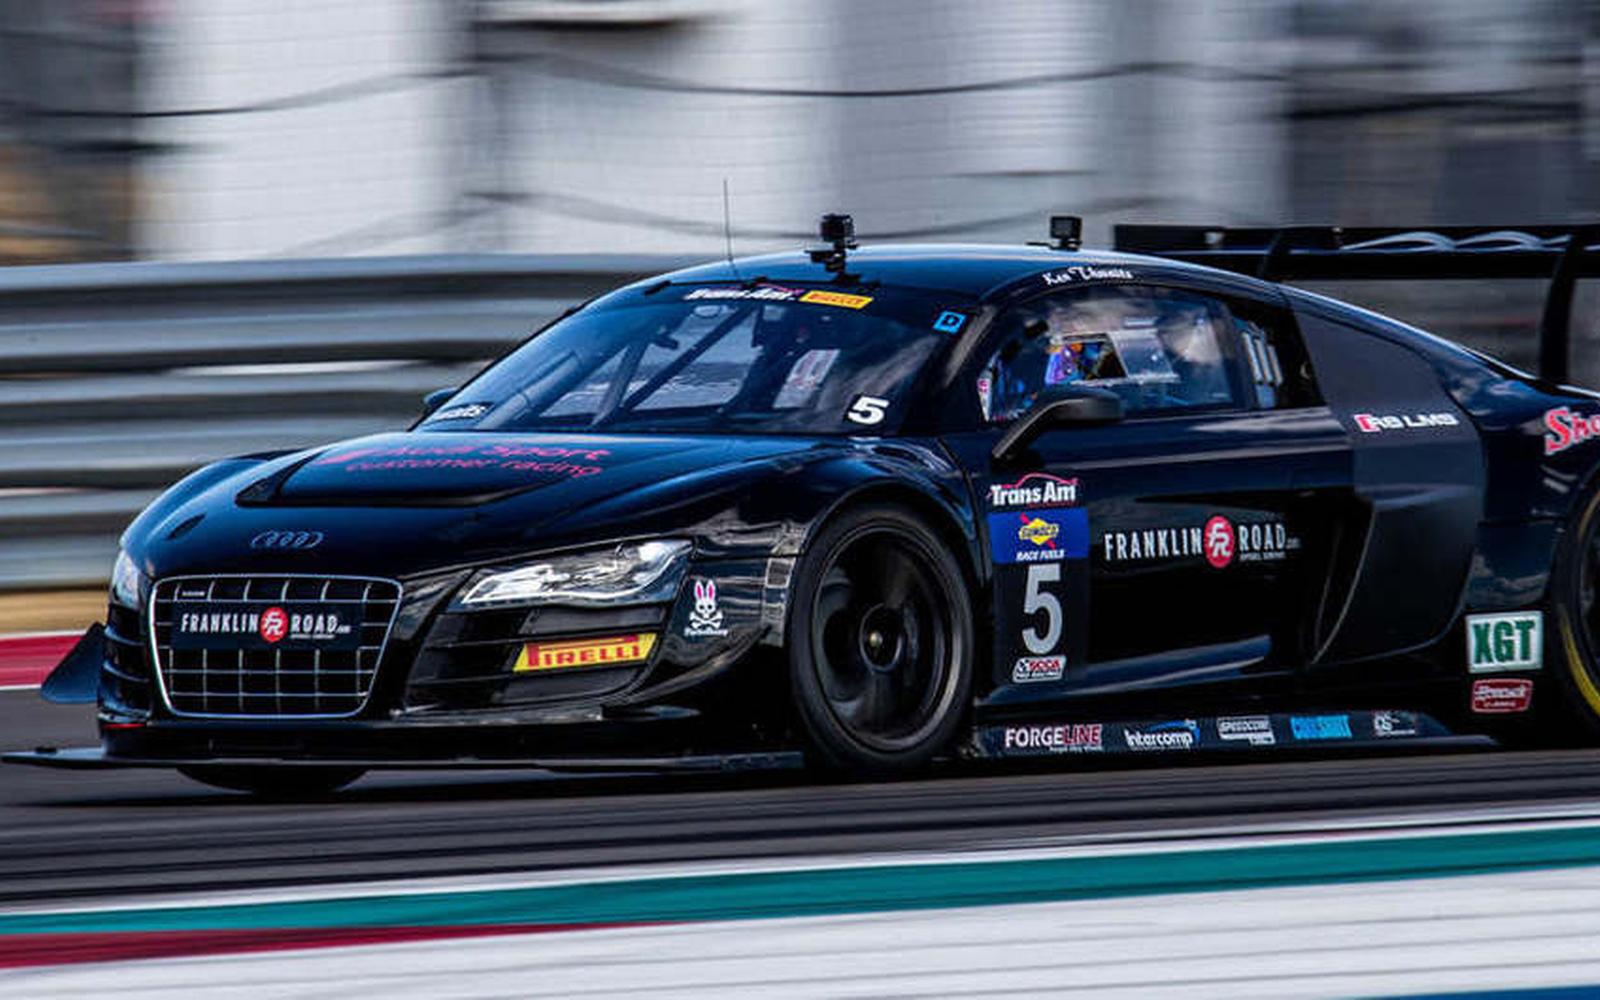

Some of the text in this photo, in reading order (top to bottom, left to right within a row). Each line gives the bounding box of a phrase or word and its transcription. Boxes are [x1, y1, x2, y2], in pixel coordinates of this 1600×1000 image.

[847, 396, 890, 425] 5
[1104, 527, 1203, 561] FRANKLIN
[181, 613, 260, 633] FRANKLIN
[1022, 562, 1062, 655] 5
[526, 634, 641, 668] PIRELLI
[1471, 620, 1536, 664] XGT
[1005, 724, 1103, 748] FORGELINE
[1124, 728, 1194, 751] Intercomp
